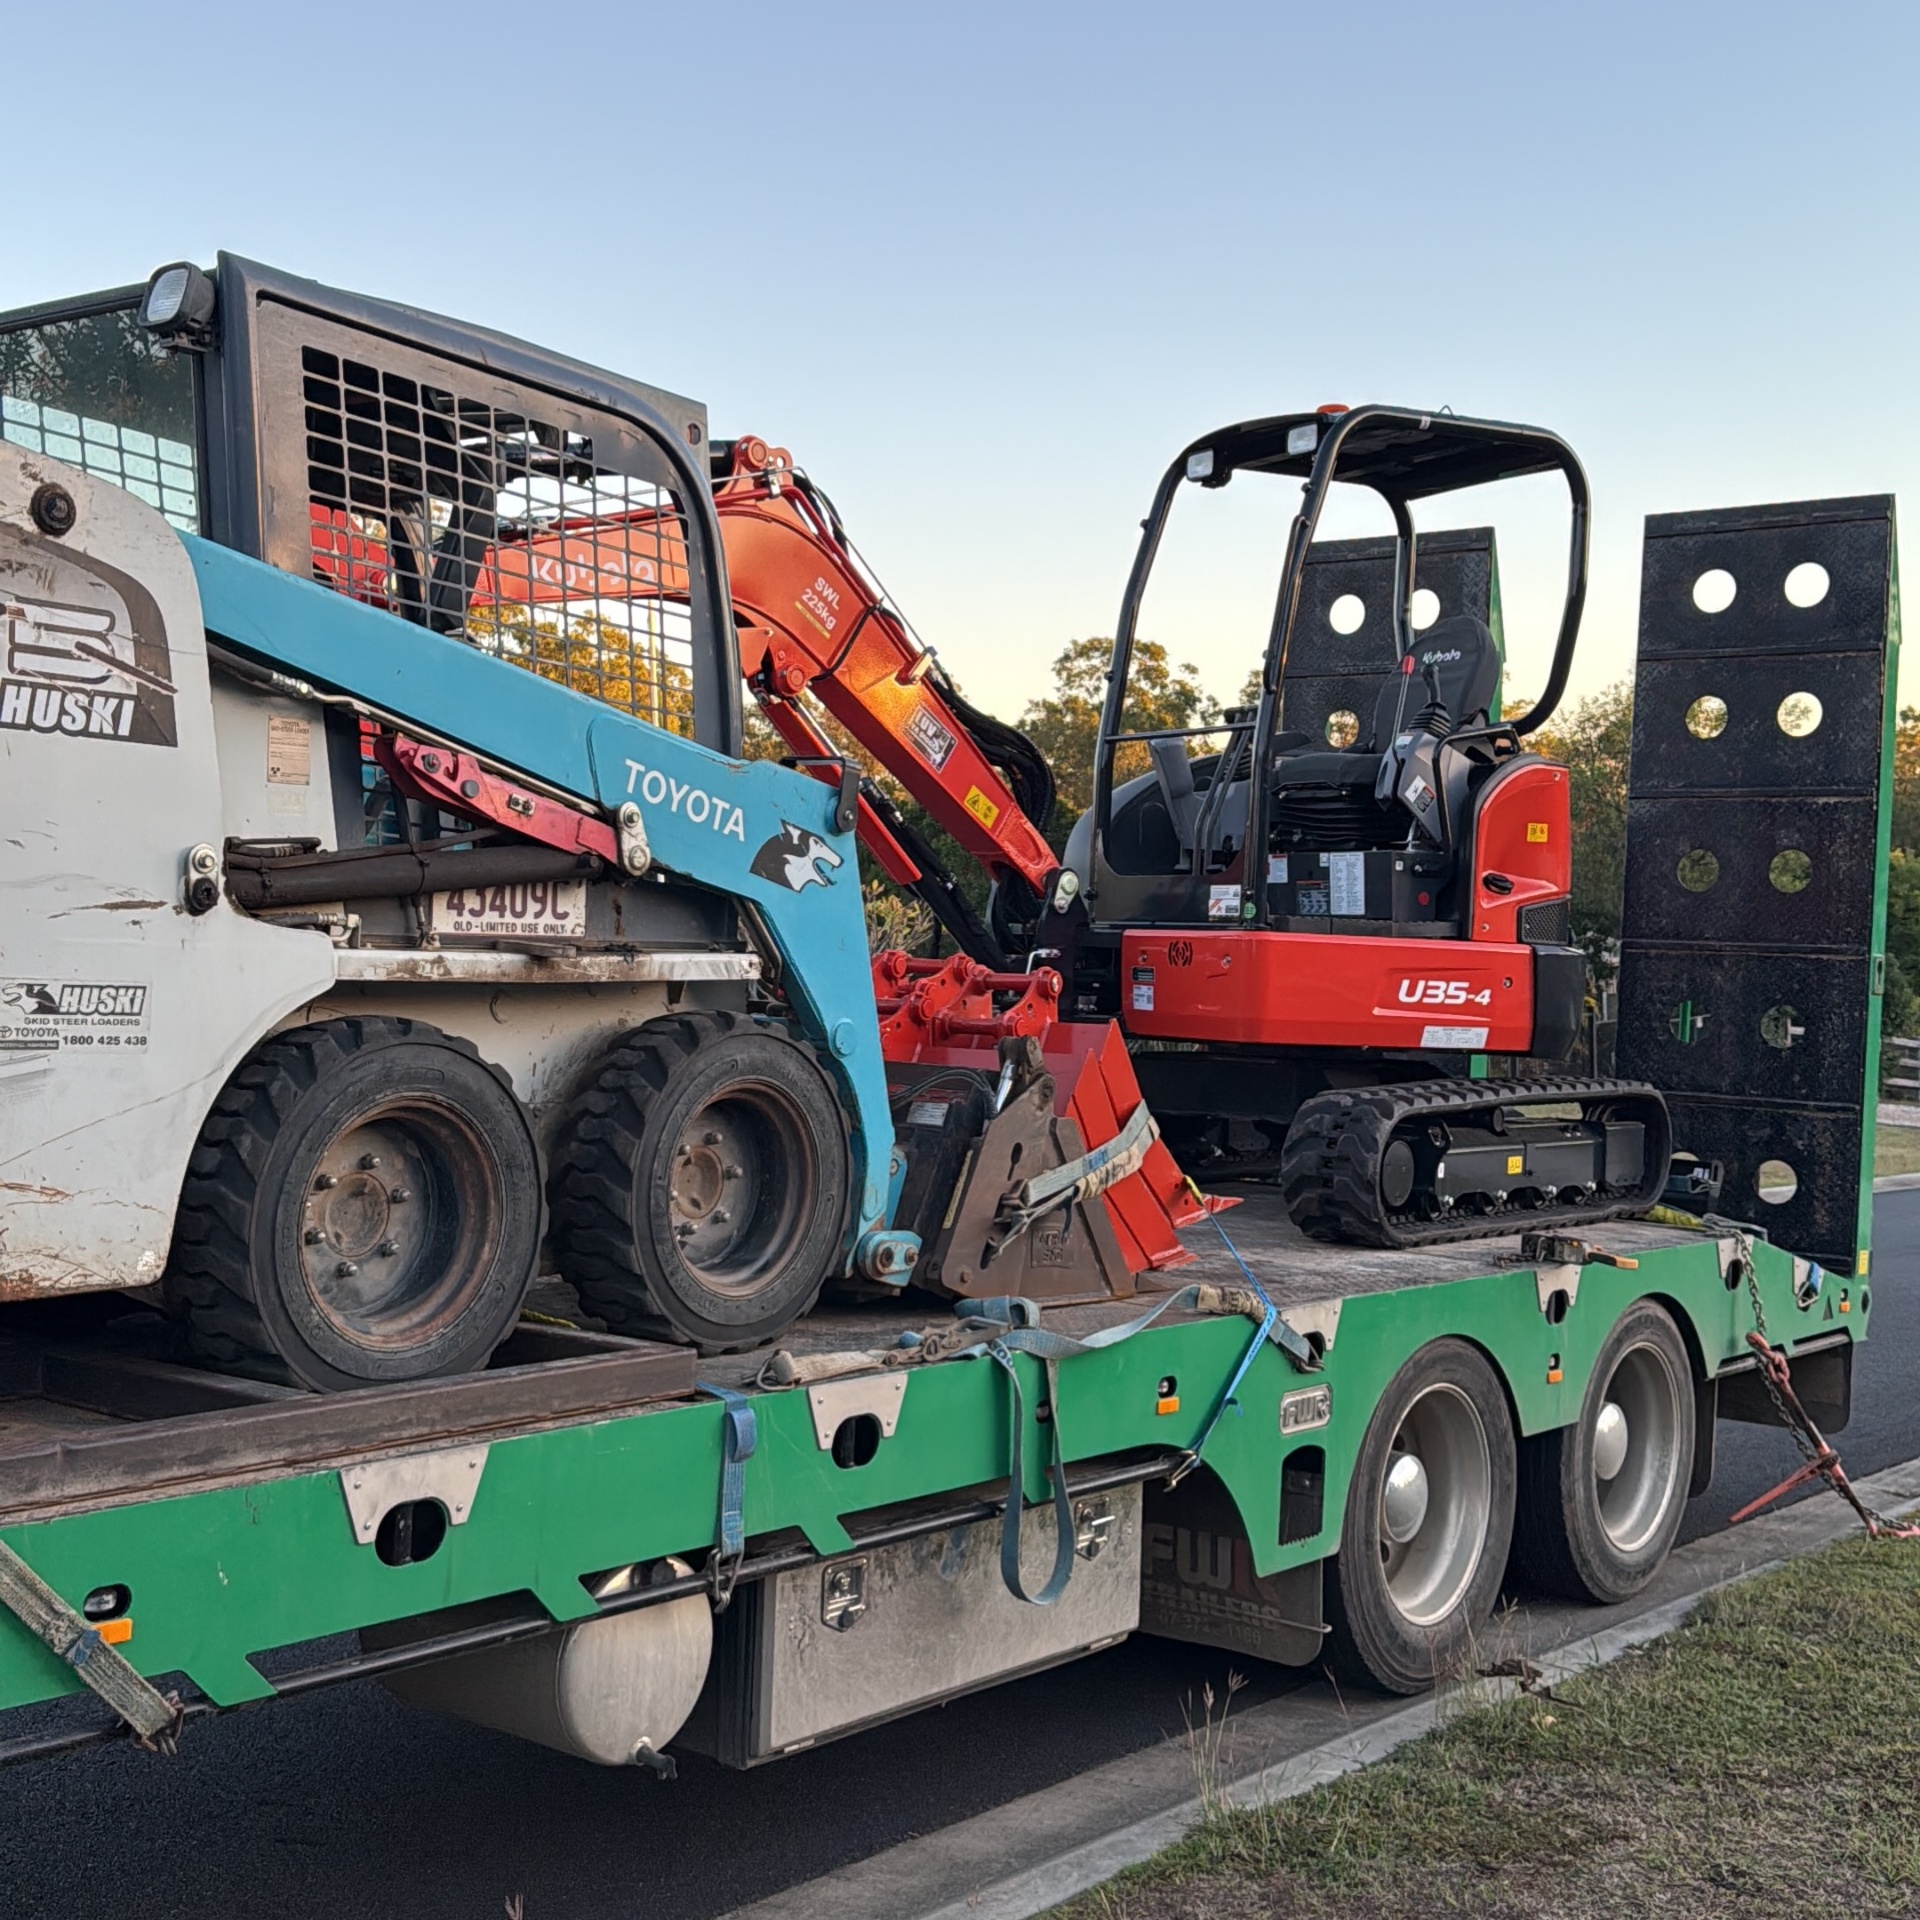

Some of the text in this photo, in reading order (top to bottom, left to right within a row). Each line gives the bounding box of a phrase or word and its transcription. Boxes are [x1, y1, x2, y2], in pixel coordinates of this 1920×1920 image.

[814, 576, 840, 611] SWL
[801, 588, 836, 630] 225kg
[1422, 648, 1462, 664] Kubota
[1, 685, 135, 737] HUSKI
[625, 759, 745, 842] TOYOTA
[521, 922, 539, 933] USE
[59, 985, 146, 1016] HUSKI
[1398, 979, 1491, 1006] U35-4
[14, 1027, 60, 1038] TOYOTA
[24, 1017, 140, 1027] SKID STEER LOADERS
[62, 1035, 148, 1046] 1800 425 438
